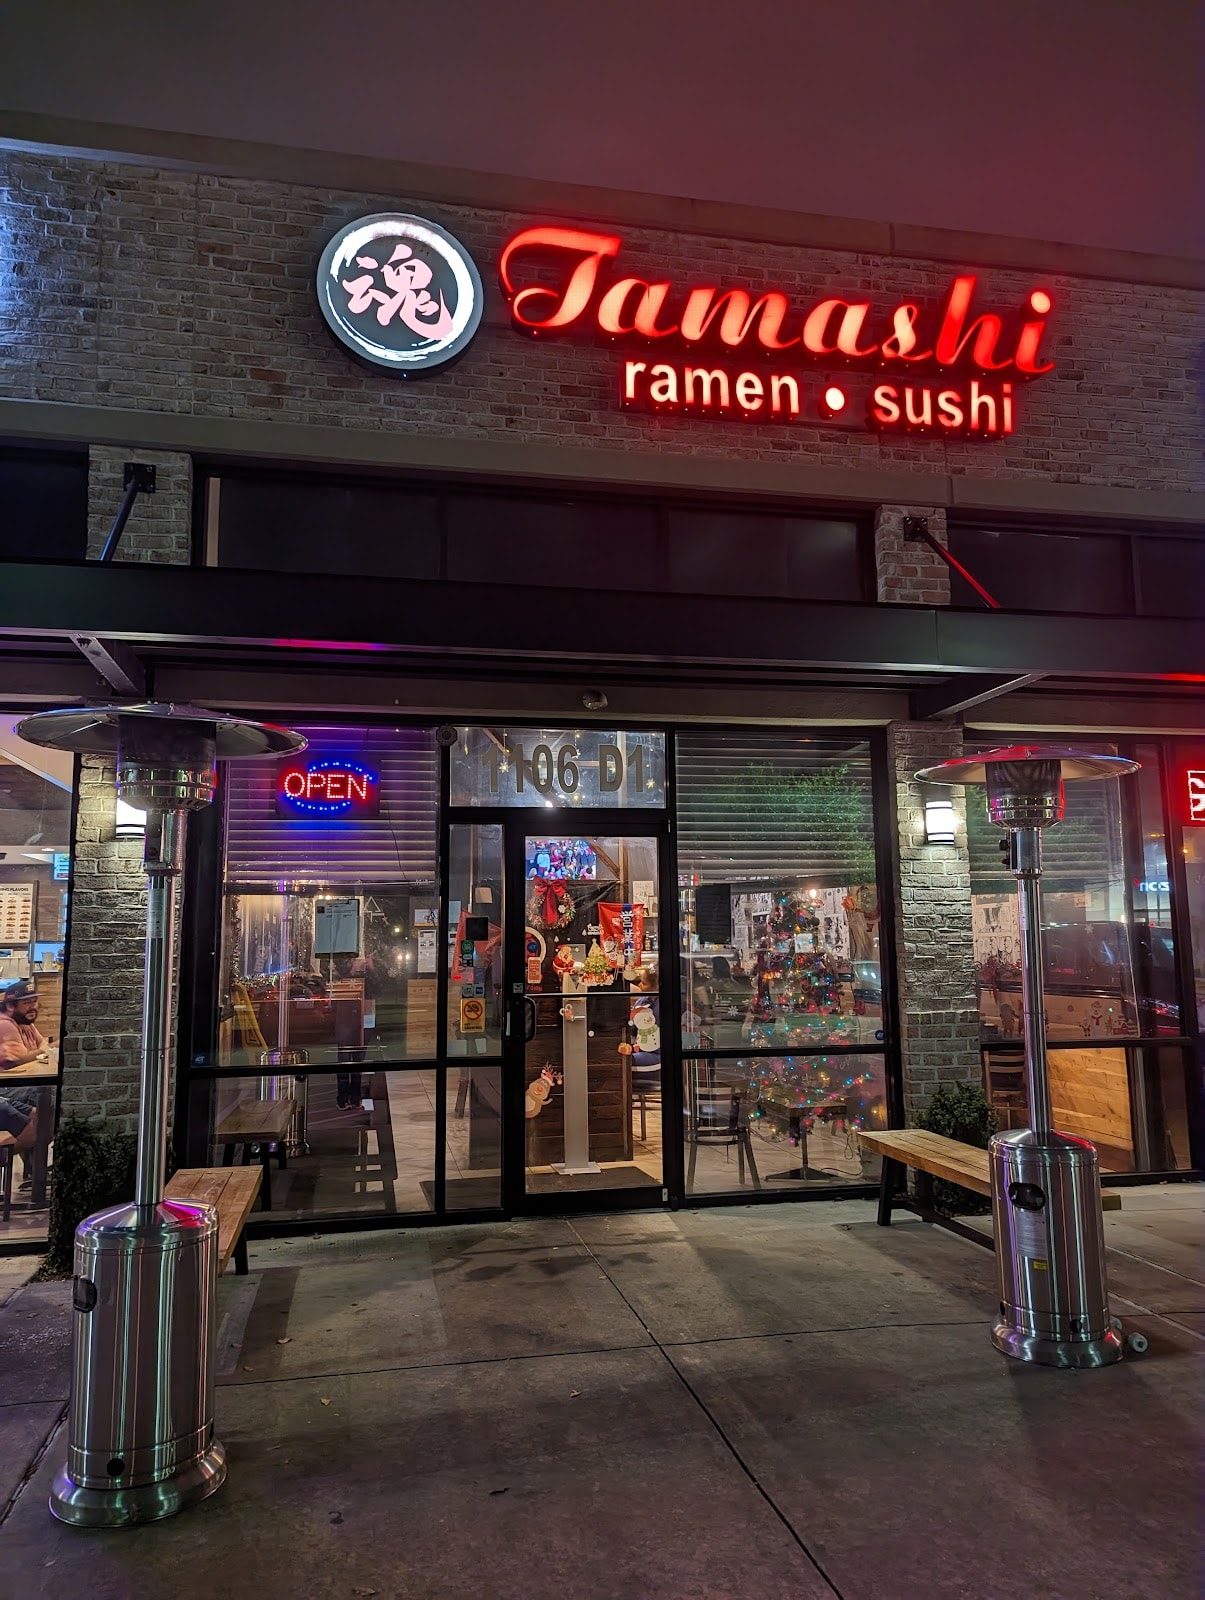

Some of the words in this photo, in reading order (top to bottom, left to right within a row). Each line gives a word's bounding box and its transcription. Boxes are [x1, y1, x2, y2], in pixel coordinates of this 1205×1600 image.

[342, 243, 453, 341] 魂
[500, 228, 1056, 373] Tamashi
[625, 361, 799, 414] ramen
[874, 381, 1012, 433] sushi
[284, 772, 366, 800] OPEN
[481, 743, 579, 794] 1106
[598, 744, 645, 794] D1
